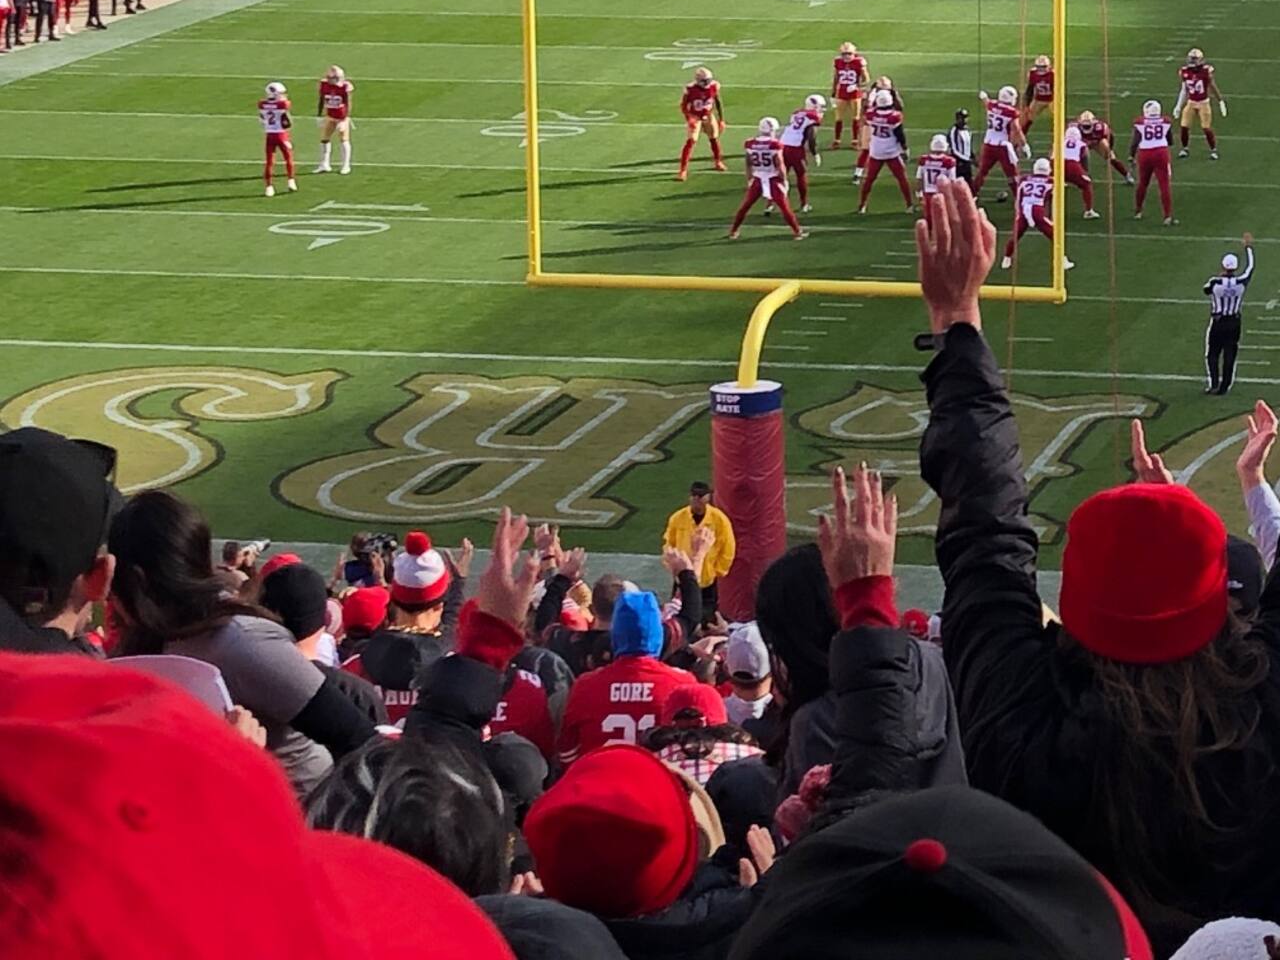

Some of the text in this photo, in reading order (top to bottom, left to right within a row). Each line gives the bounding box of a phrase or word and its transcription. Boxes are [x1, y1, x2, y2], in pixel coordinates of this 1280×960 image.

[268, 111, 276, 125] 2
[1143, 125, 1163, 141] 68
[1023, 183, 1047, 199] 23
[267, 200, 431, 237] 10
[716, 395, 741, 404] STOP
[610, 682, 656, 702] GORE
